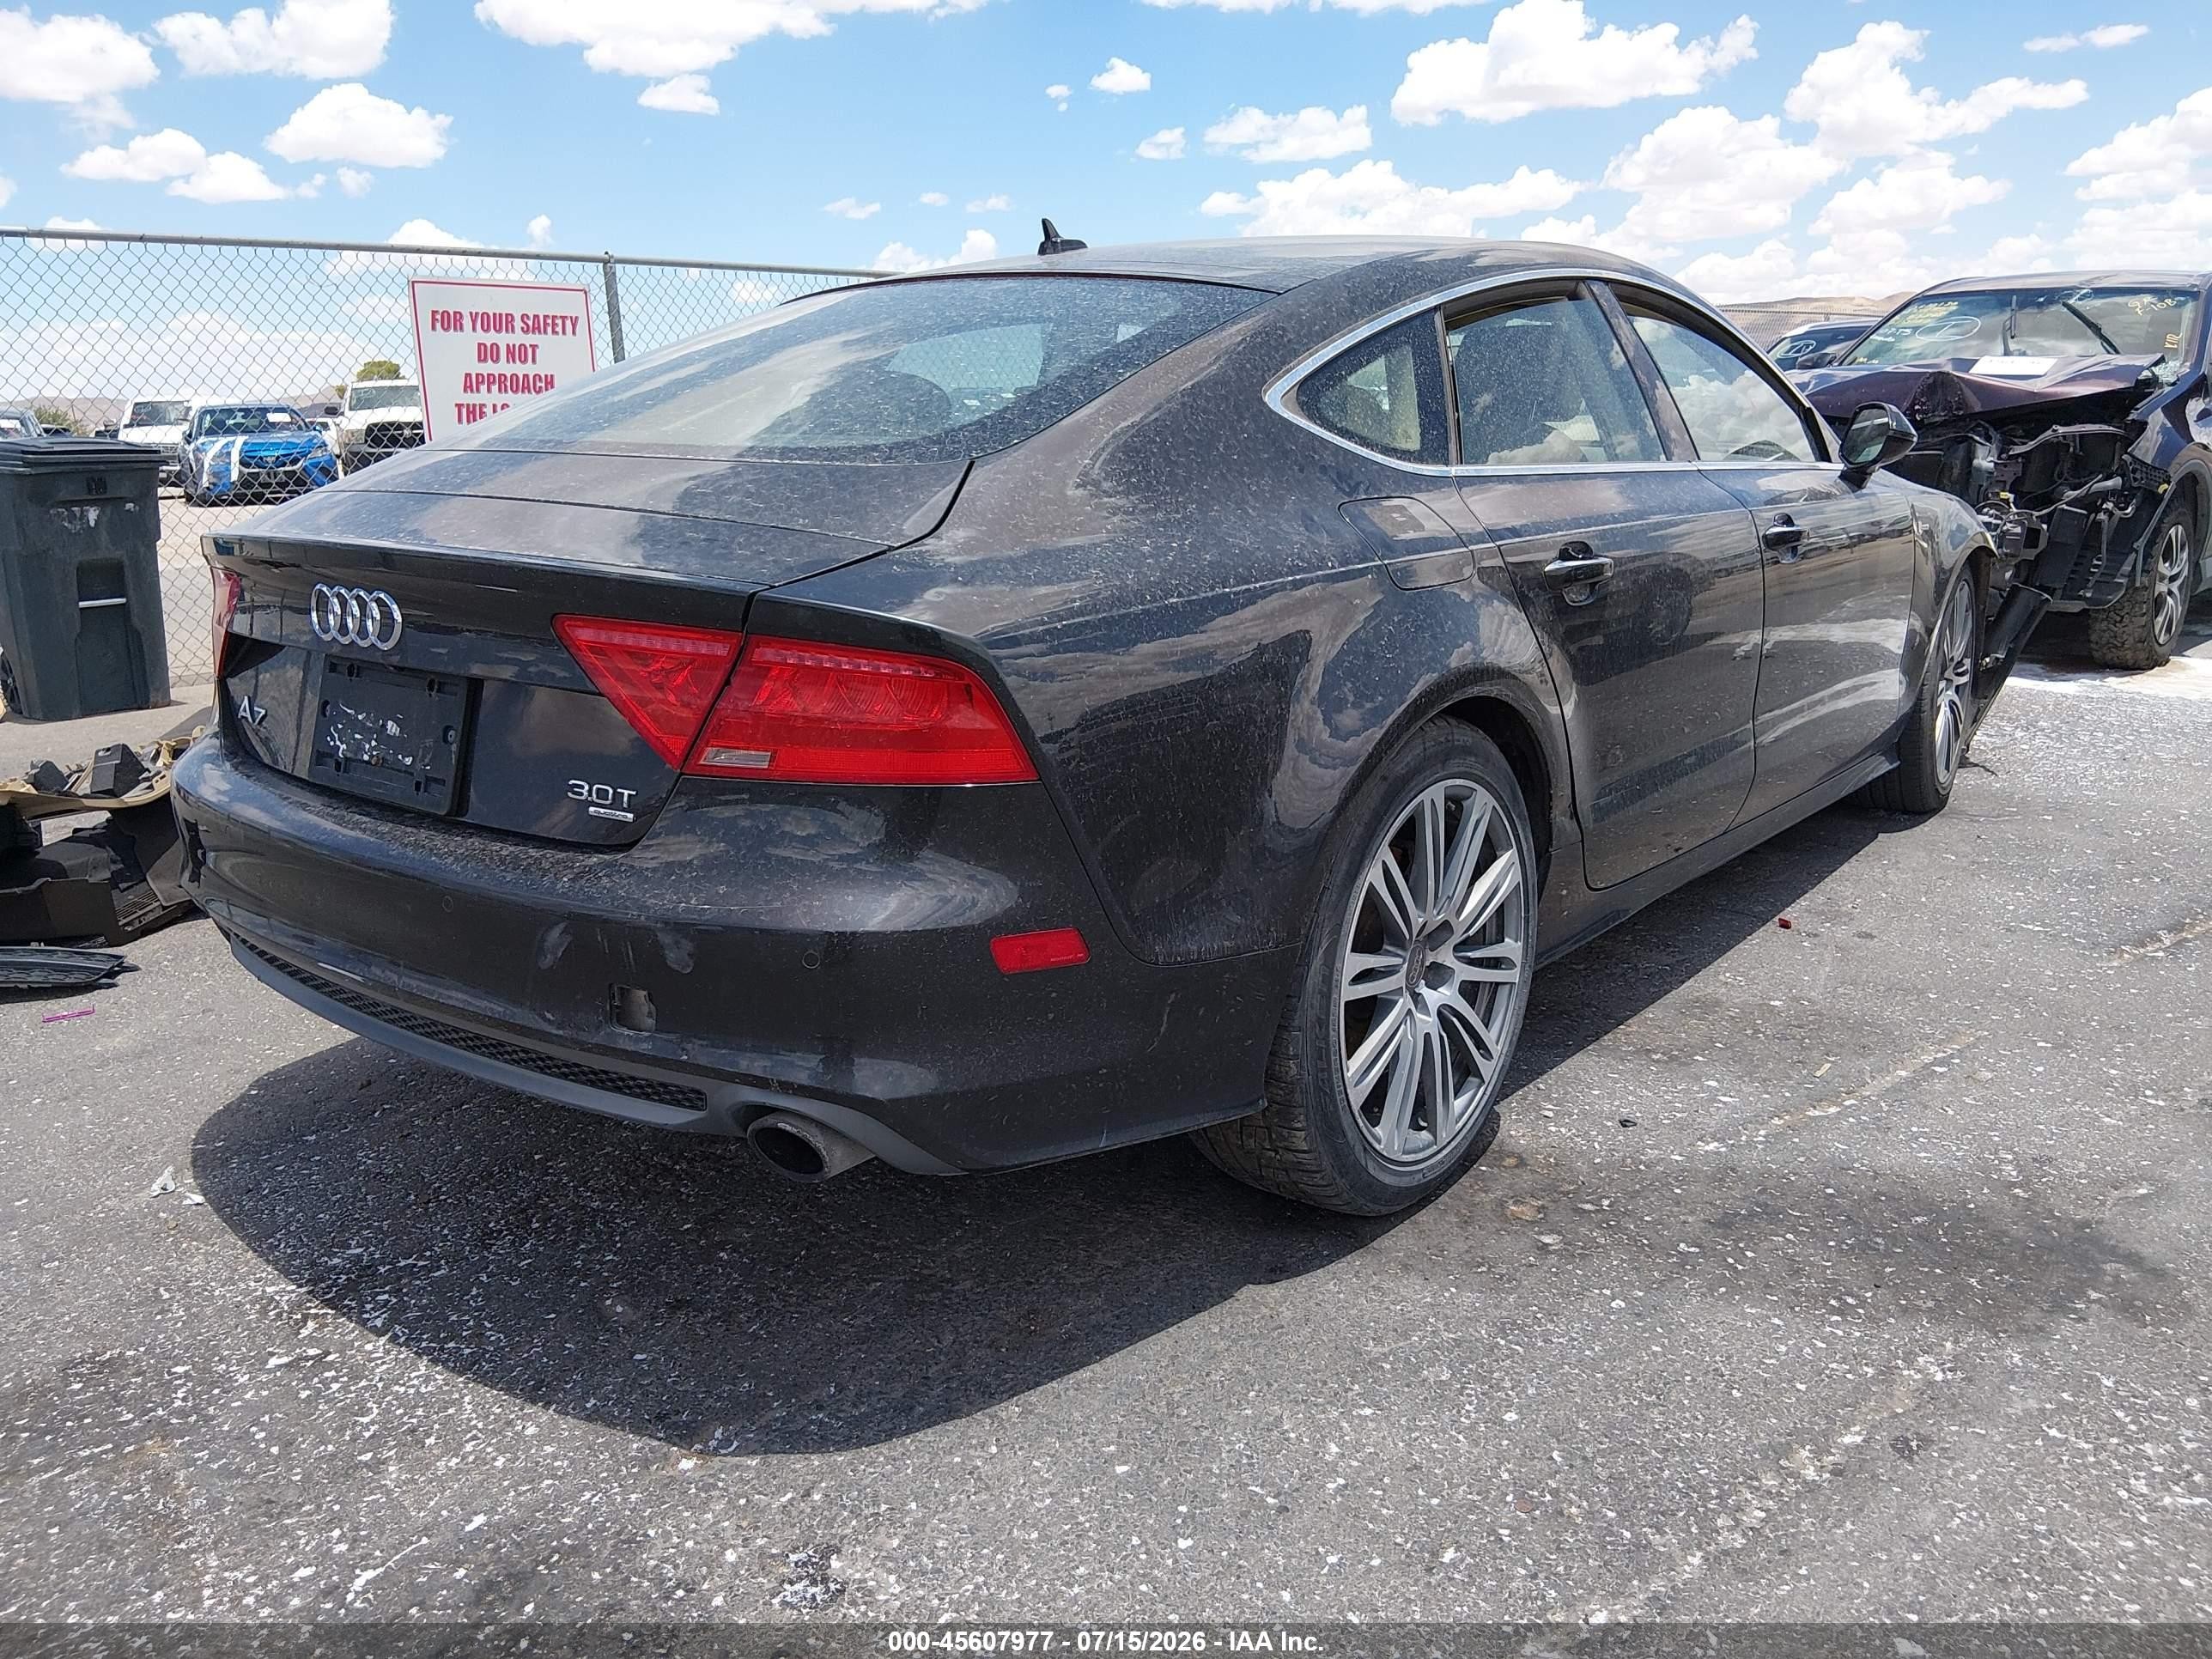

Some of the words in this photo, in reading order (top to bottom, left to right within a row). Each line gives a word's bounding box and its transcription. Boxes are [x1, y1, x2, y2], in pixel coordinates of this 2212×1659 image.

[430, 310, 465, 332] FOR
[469, 311, 516, 334] YOUR
[520, 313, 580, 337] SAFETY
[477, 342, 501, 364] DO
[506, 343, 539, 365] NOT
[463, 373, 556, 395] APPROACH
[455, 403, 488, 426] THE
[238, 695, 267, 726] A7
[567, 780, 637, 809] 3.0T
[592, 809, 629, 820] quattro
